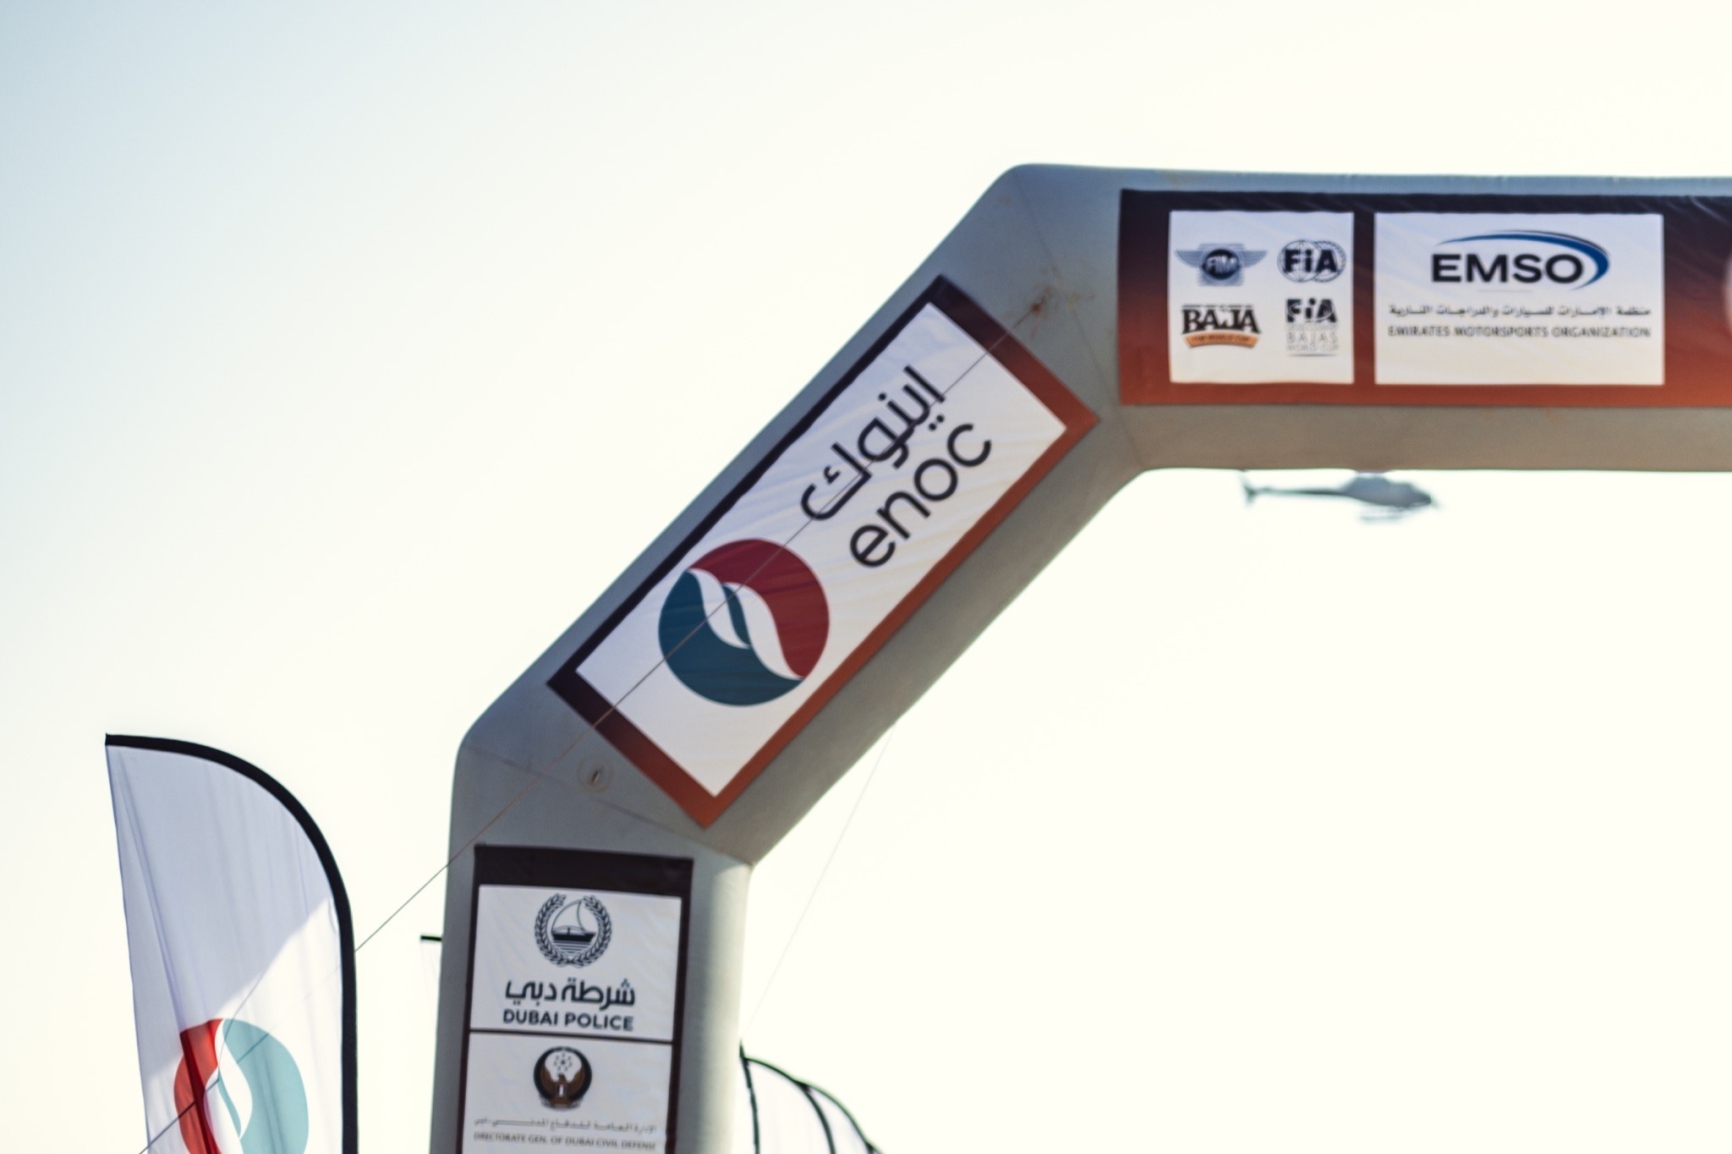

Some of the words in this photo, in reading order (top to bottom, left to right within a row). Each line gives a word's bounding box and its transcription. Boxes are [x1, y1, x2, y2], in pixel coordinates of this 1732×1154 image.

[1431, 253, 1584, 284] EMSO
[1182, 307, 1261, 334] BAJA
[1388, 326, 1450, 337] EMIRATES
[1455, 326, 1549, 337] MOTORSPORTS
[1552, 326, 1651, 337] ORGANIZATION
[850, 423, 992, 568] enoc
[505, 980, 557, 1006] دبي
[561, 978, 635, 1011] شرطة
[503, 1008, 558, 1027] DUBAI
[565, 1012, 633, 1031] POLICE
